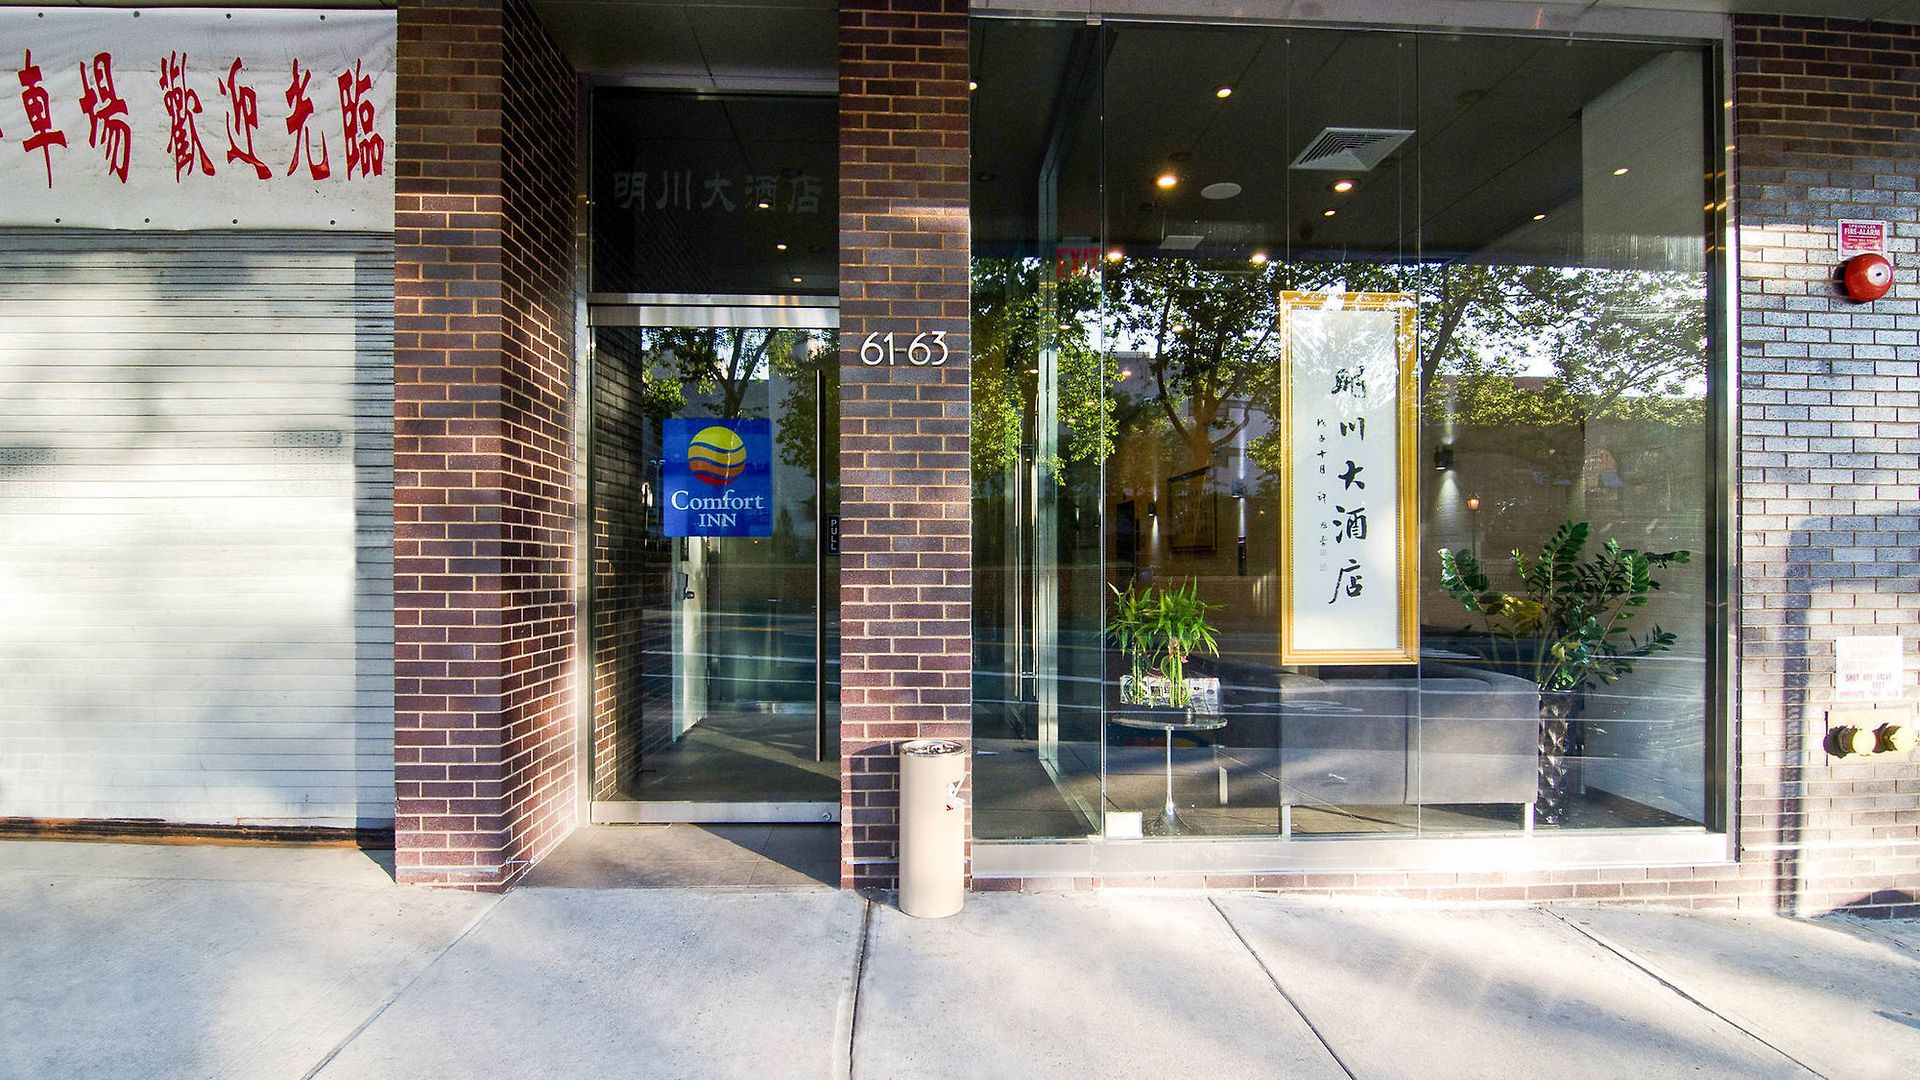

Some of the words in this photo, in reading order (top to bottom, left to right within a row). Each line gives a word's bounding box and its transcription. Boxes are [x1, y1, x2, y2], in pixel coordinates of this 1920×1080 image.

[0, 49, 385, 189] 車場歡迎光臨
[613, 169, 823, 213] 明川大酒店
[1844, 228, 1881, 236] FIRE-ALARM
[1056, 247, 1099, 279] EXIT
[860, 330, 949, 367] 61-63
[671, 489, 765, 511] Comfort
[698, 513, 737, 528] INN
[830, 519, 838, 551] PULL
